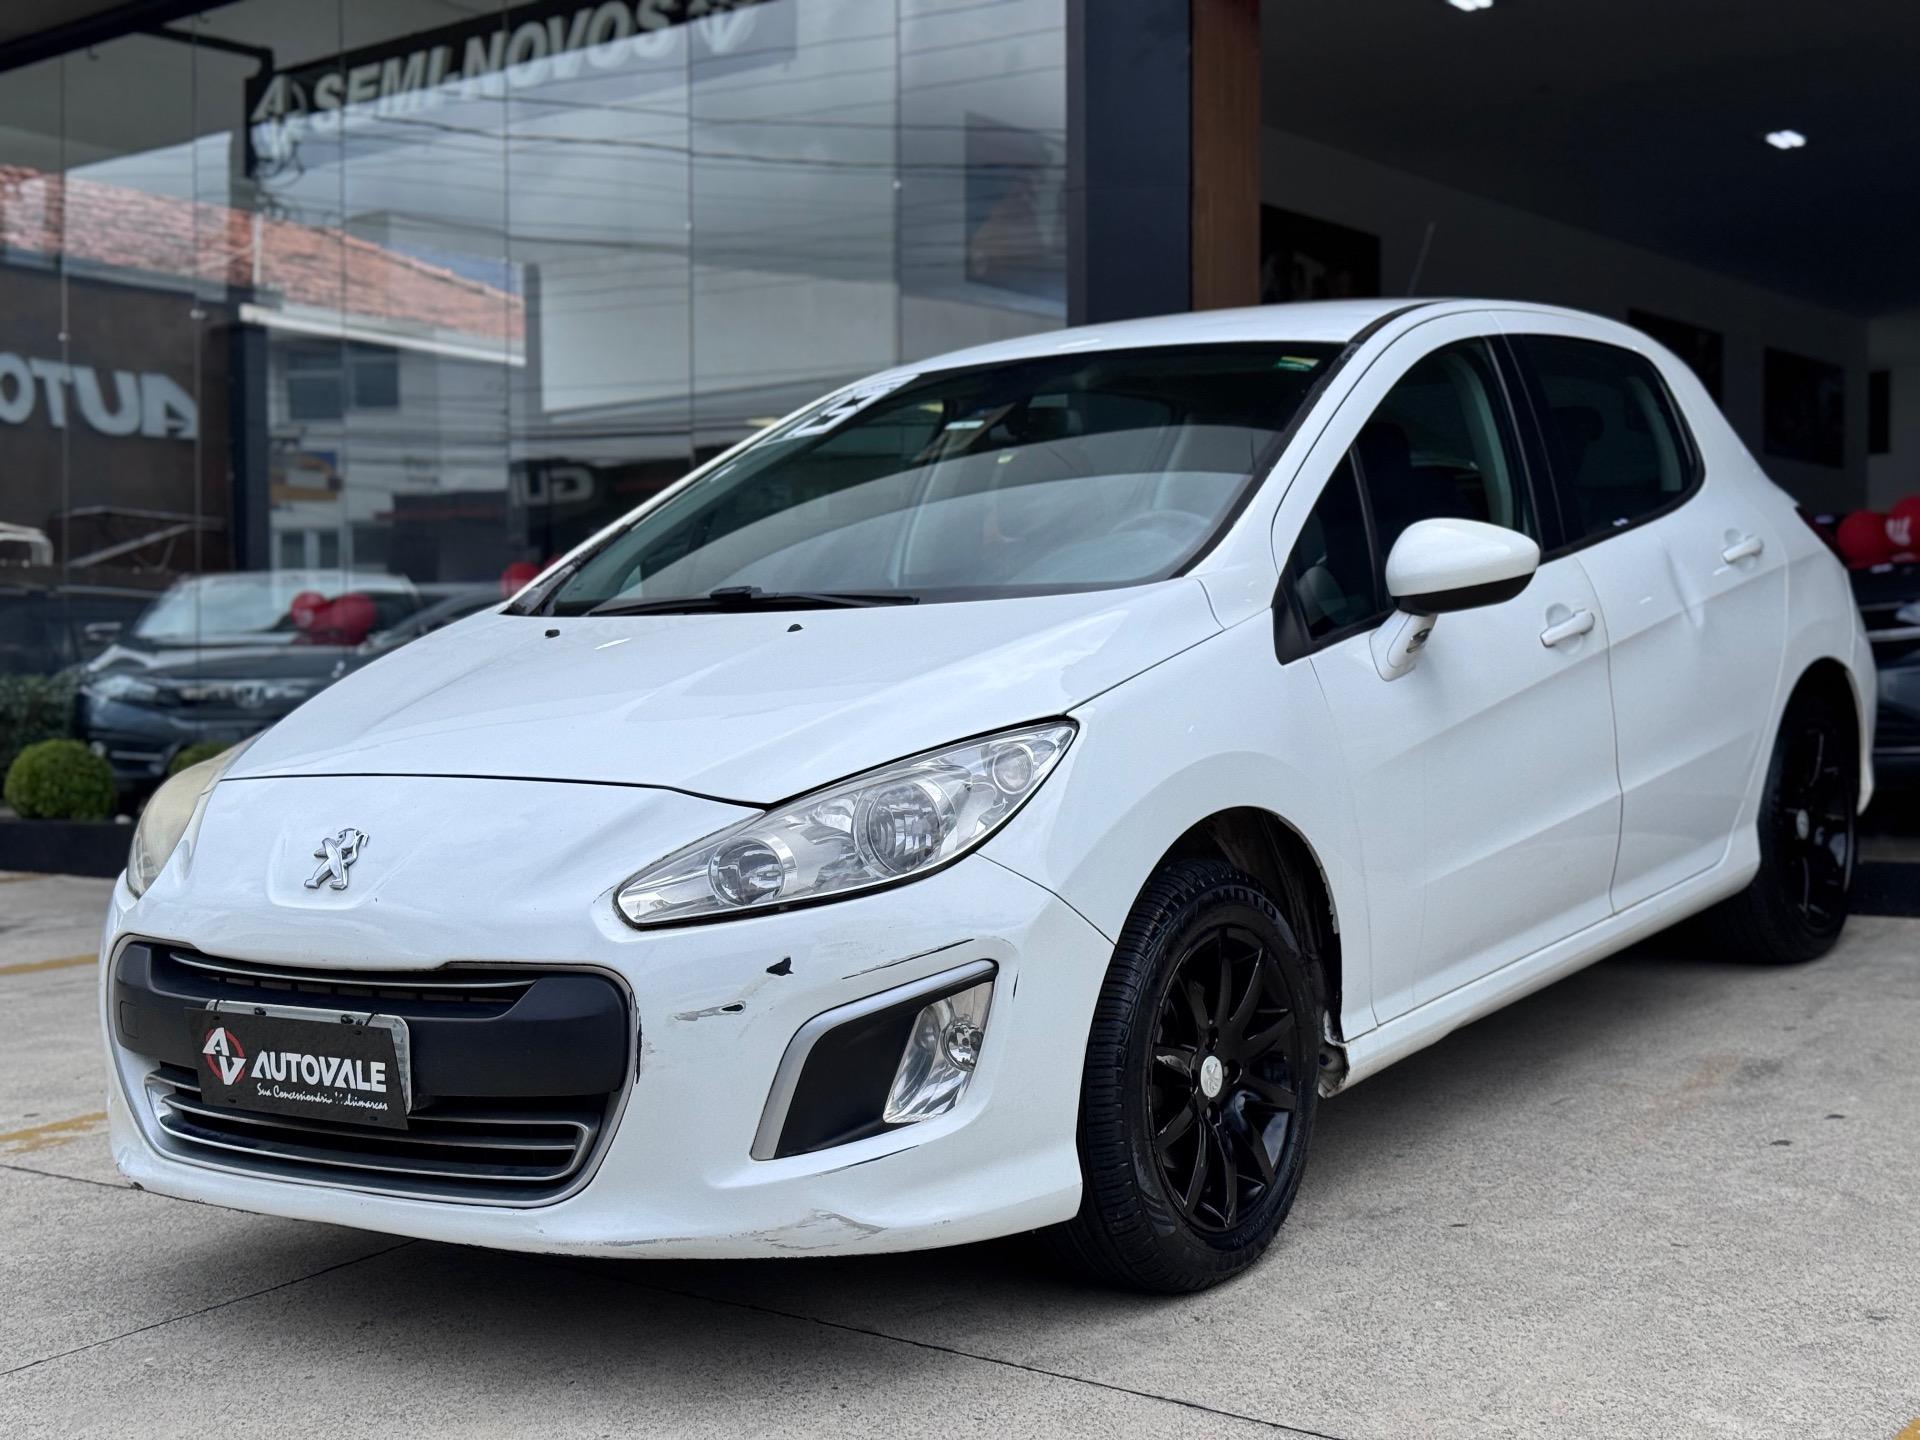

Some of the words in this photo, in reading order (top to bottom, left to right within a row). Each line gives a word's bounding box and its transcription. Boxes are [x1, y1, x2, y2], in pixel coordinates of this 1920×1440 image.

[313, 0, 677, 130] SEMI-NOVOS
[251, 1050, 387, 1093] AUTOVALE
[256, 1082, 272, 1097] Sua
